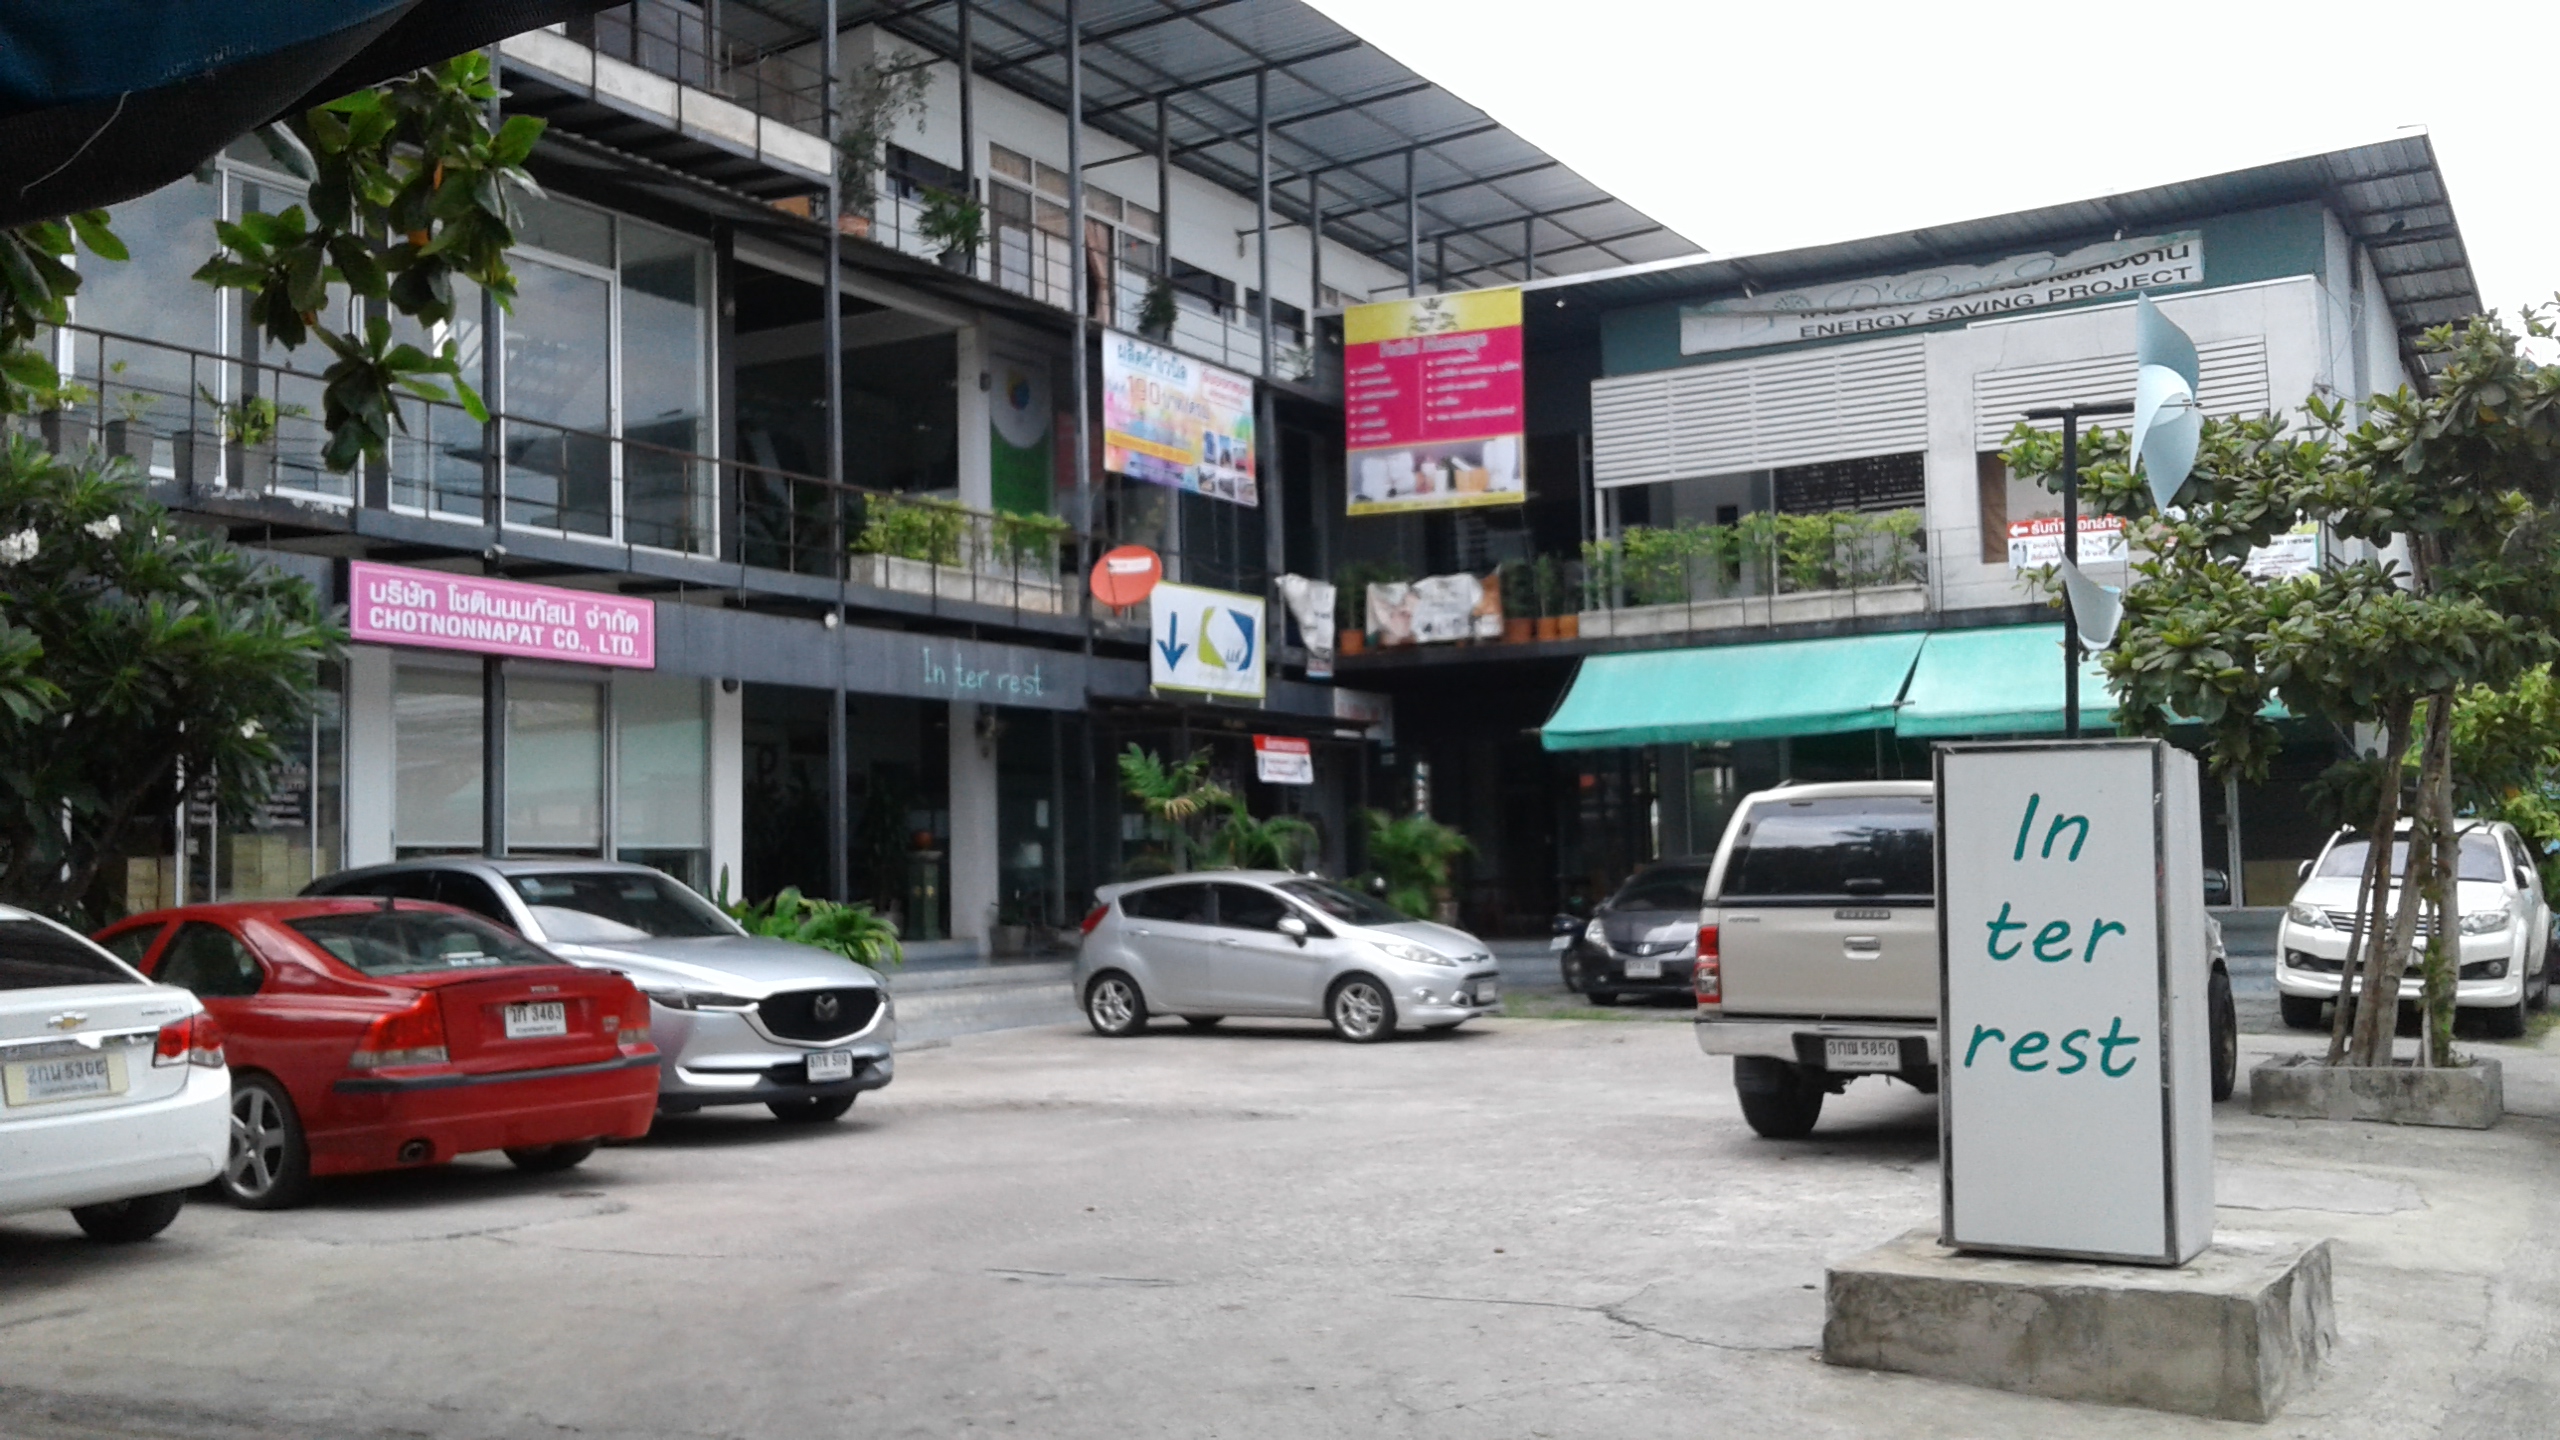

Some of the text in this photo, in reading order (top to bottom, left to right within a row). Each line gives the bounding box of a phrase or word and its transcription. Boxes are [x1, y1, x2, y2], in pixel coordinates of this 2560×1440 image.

[1800, 312, 1915, 338] ENERGY
[1927, 294, 2034, 321] SAVING
[2048, 266, 2193, 302] PROJECT
[2031, 517, 2122, 535] รับถ่าอกสาร
[369, 579, 436, 609] บริษัท
[585, 607, 640, 635] จำกัด
[369, 606, 545, 647] CHOTNONNAPAT
[923, 646, 1044, 696] In ter rest
[2013, 792, 2089, 862] In
[1986, 902, 2127, 963] ter
[1964, 1016, 2140, 1078] rest
